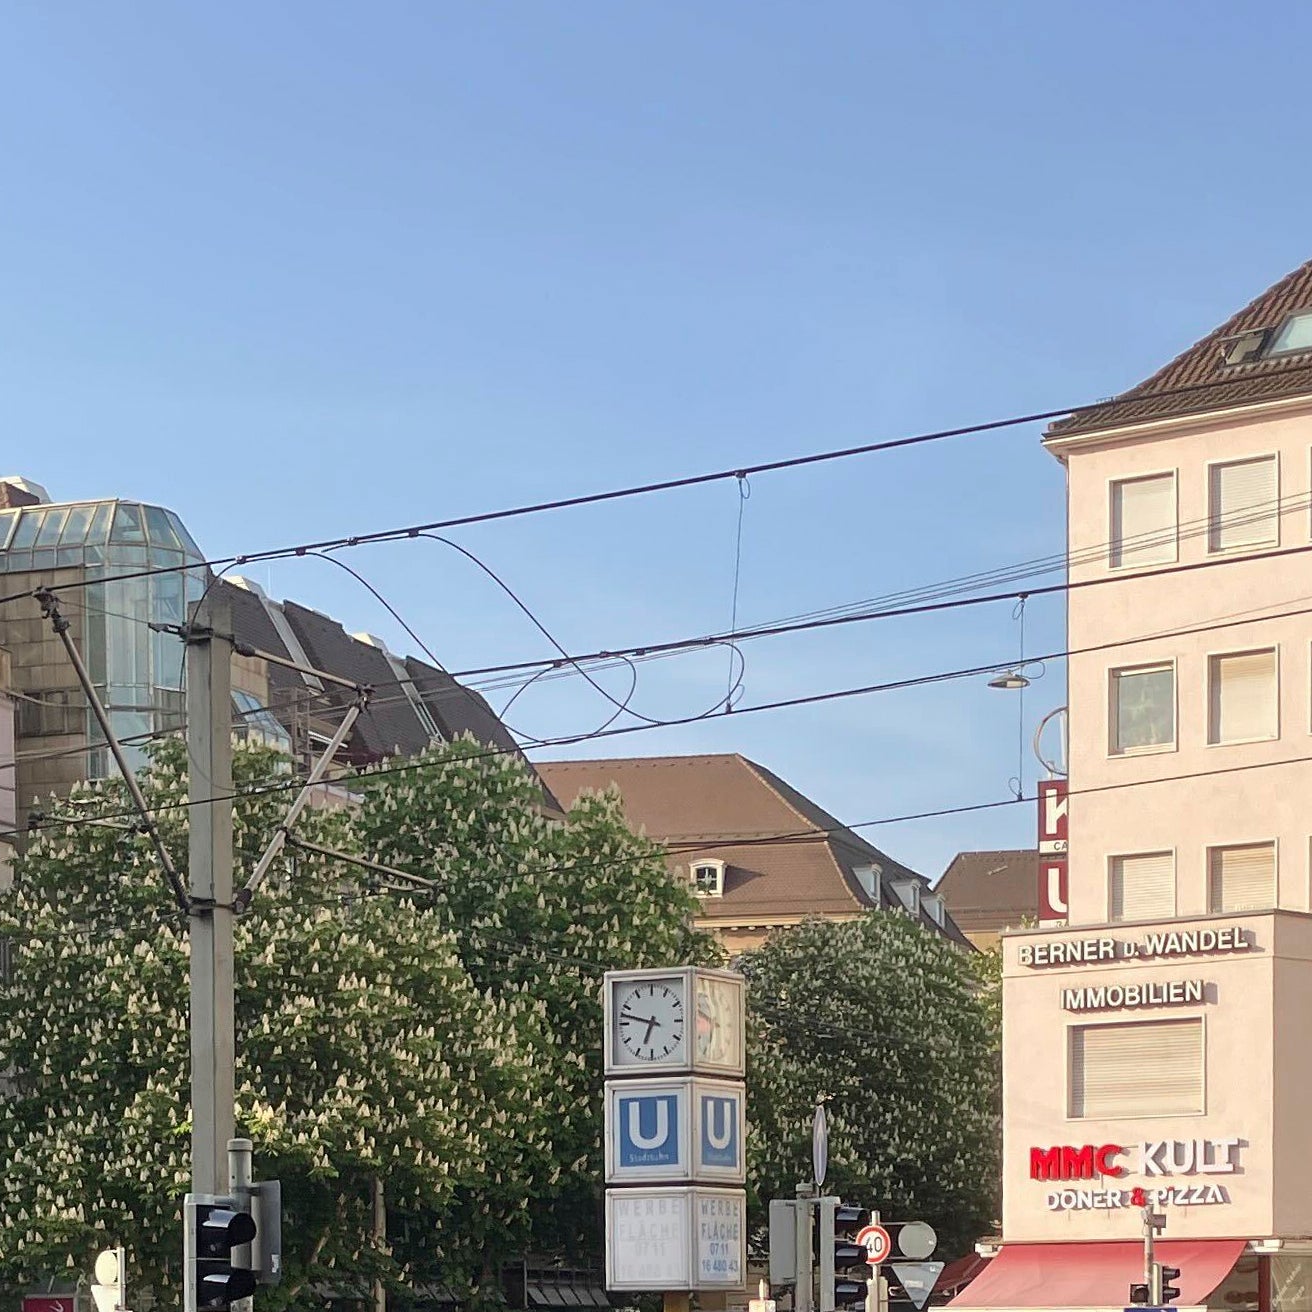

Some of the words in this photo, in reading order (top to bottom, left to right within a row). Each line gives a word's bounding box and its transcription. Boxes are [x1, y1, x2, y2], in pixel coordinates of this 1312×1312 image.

[1018, 937, 1115, 966] BERNER
[1145, 927, 1249, 955] WANDEL
[1060, 979, 1205, 1010] IMMOBILIEN
[628, 1100, 670, 1150] U
[707, 1100, 732, 1150] U
[1030, 1143, 1124, 1180] MMC
[1141, 1137, 1240, 1176] KULT
[701, 1200, 739, 1217] WERBE
[1130, 1186, 1146, 1207] &
[865, 1236, 883, 1253] 40
